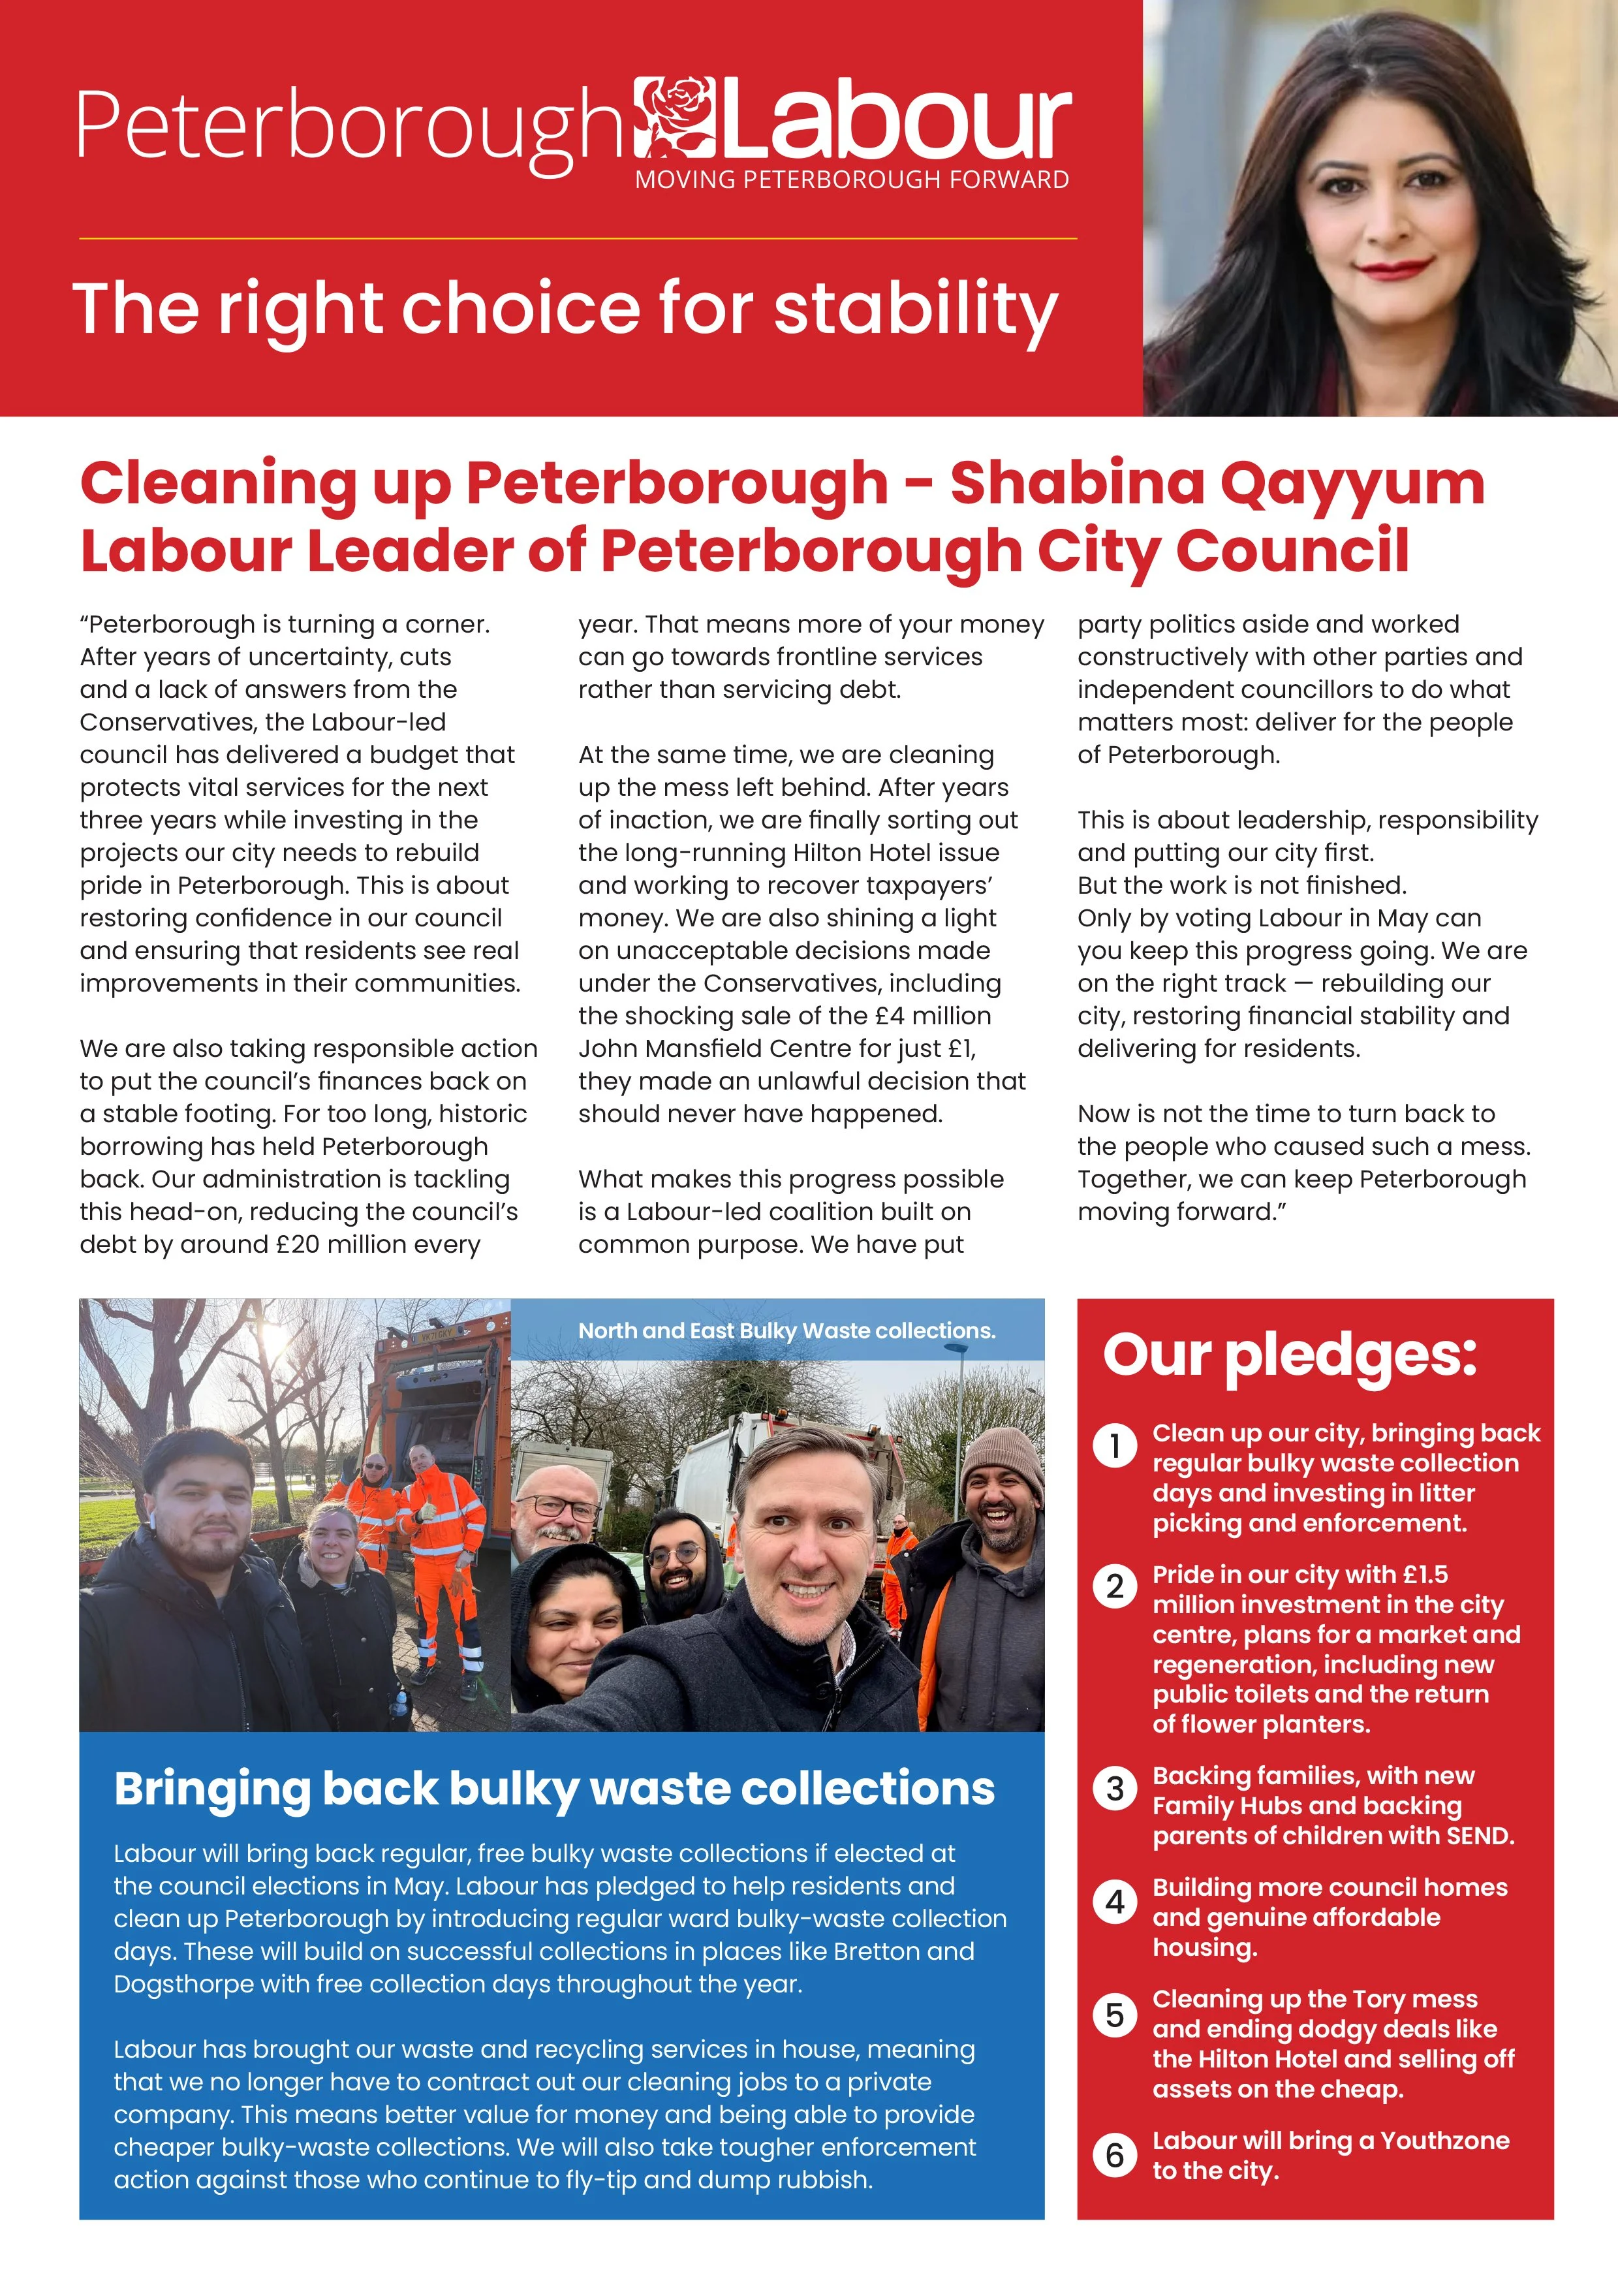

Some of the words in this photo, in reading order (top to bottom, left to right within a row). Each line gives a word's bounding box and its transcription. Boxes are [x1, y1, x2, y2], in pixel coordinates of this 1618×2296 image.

[724, 76, 1073, 160] Labour
[79, 86, 622, 180] Peterborough
[636, 170, 734, 189] MOVING
[745, 170, 940, 189] PETERBOROUGH
[951, 170, 1069, 189] FORWARD
[72, 279, 198, 334] The
[221, 277, 383, 353] right
[403, 277, 640, 334] choice
[659, 277, 754, 334] for
[775, 277, 1059, 352] stability
[81, 455, 356, 520] Cleaning
[374, 469, 452, 520] up
[469, 458, 887, 520] Peterborough
[952, 455, 1204, 505] Shabina
[1221, 460, 1484, 520] Qayyum
[83, 526, 292, 573] Labour
[309, 526, 514, 573] Leader
[529, 524, 587, 573] of
[603, 526, 1021, 588] Peterborough
[1038, 522, 1162, 588] City
[1177, 523, 1408, 573] Council
[80, 614, 255, 640] “Peterborough
[263, 614, 281, 633] is
[288, 614, 374, 640] turning
[382, 618, 397, 633] a
[406, 618, 490, 633] corner.
[578, 618, 638, 640] year.
[645, 614, 698, 633] That
[707, 618, 790, 633] means
[798, 618, 862, 633] more
[869, 613, 892, 633] of
[899, 618, 953, 640] your
[961, 618, 1045, 640] money
[1078, 646, 1249, 672] constructively
[1255, 646, 1305, 666] with
[1313, 646, 1377, 666] other
[1385, 646, 1468, 672] parties
[1476, 646, 1522, 666] and
[80, 712, 258, 734] Conservatives,
[265, 712, 305, 731] the
[313, 712, 445, 731] Labour-led
[1078, 744, 1101, 764] of
[1109, 744, 1280, 770] Peterborough.
[578, 842, 618, 862] the
[626, 842, 785, 868] long-running
[794, 842, 861, 862] Hilton
[870, 842, 930, 862] Hotel
[939, 841, 1000, 862] issue
[81, 875, 142, 901] pride
[150, 875, 170, 894] in
[179, 875, 349, 901] Peterborough.
[356, 875, 404, 894] This
[411, 875, 429, 894] is
[437, 875, 509, 894] about
[81, 1136, 202, 1162] borrowing
[211, 1136, 255, 1156] has
[263, 1136, 314, 1156] held
[323, 1136, 488, 1162] Peterborough
[1078, 1169, 1192, 1195] Together,
[1198, 1173, 1234, 1188] we
[1241, 1173, 1286, 1188] can
[1295, 1169, 1353, 1195] keep
[1361, 1169, 1526, 1195] Peterborough
[1079, 1201, 1170, 1227] moving
[1177, 1201, 1286, 1221] forward.”
[579, 1238, 689, 1253] common
[698, 1238, 803, 1260] purpose.
[811, 1235, 849, 1253] We
[857, 1234, 917, 1253] have
[925, 1235, 964, 1260] put
[1104, 1332, 1212, 1376] Our
[1226, 1330, 1476, 1392] pledges:
[1110, 1433, 1119, 1458] 1
[1153, 1423, 1224, 1442] Clean
[1232, 1427, 1262, 1449] up
[1269, 1427, 1309, 1442] our
[1315, 1422, 1365, 1448] city,
[1373, 1422, 1474, 1449] bringing
[1482, 1423, 1541, 1442] back
[1154, 1512, 1241, 1539] picking
[1249, 1513, 1296, 1532] and
[1303, 1513, 1467, 1532] enforcement.
[1107, 1573, 1124, 1598] 2
[1154, 1564, 1215, 1584] Pride
[1221, 1564, 1241, 1584] in
[1249, 1569, 1289, 1584] our
[1296, 1564, 1339, 1590] city
[1345, 1564, 1396, 1584] with
[1403, 1565, 1448, 1584] £1.5
[1153, 1713, 1176, 1733] of
[1181, 1713, 1257, 1733] flower
[1264, 1714, 1371, 1740] planters.
[1107, 1776, 1124, 1801] 3
[1154, 1765, 1251, 1791] Backing
[1257, 1765, 1360, 1788] families,
[1367, 1765, 1418, 1785] with
[1425, 1770, 1475, 1785] new
[116, 1767, 310, 1817] Bringing
[324, 1770, 439, 1805] back
[451, 1770, 580, 1817] bulky
[589, 1772, 731, 1805] waste
[741, 1767, 995, 1805] collections
[1105, 1889, 1125, 1914] 4
[1154, 1876, 1251, 1903] Building
[1259, 1881, 1323, 1896] more
[1330, 1876, 1416, 1896] council
[1425, 1878, 1508, 1896] homes
[1154, 1936, 1258, 1963] housing.
[115, 1974, 254, 2000] Dogsthorpe
[260, 1974, 309, 1993] with
[317, 1974, 362, 1993] free
[370, 1974, 485, 1993] collection
[493, 1974, 550, 1998] days
[557, 1974, 691, 2000] throughout
[699, 1974, 737, 1993] the
[744, 1979, 802, 1998] year.
[1153, 1988, 1262, 2015] Cleaning
[1271, 1993, 1301, 2015] up
[1307, 1989, 1347, 2008] the
[1353, 1990, 1406, 2014] Tory
[1413, 1993, 1478, 2008] mess
[1106, 2002, 1124, 2028] 5
[1106, 2143, 1124, 2168] 6
[1154, 2131, 1237, 2150] Labour
[1243, 2130, 1281, 2150] will
[1290, 2130, 1352, 2156] bring
[1360, 2135, 1374, 2150] a
[1381, 2131, 1510, 2150] Youthzone
[114, 2169, 189, 2189] action
[196, 2169, 287, 2195] against
[294, 2170, 360, 2189] those
[367, 2170, 417, 2189] who
[424, 2171, 529, 2189] continue
[537, 2172, 559, 2189] to
[566, 2169, 636, 2194] fly-tip
[644, 2171, 691, 2189] and
[698, 2170, 770, 2194] dump
[779, 2170, 873, 2189] rubbish.
[1153, 2162, 1177, 2180] to
[1183, 2161, 1222, 2180] the
[1229, 2160, 1279, 2186] city.
